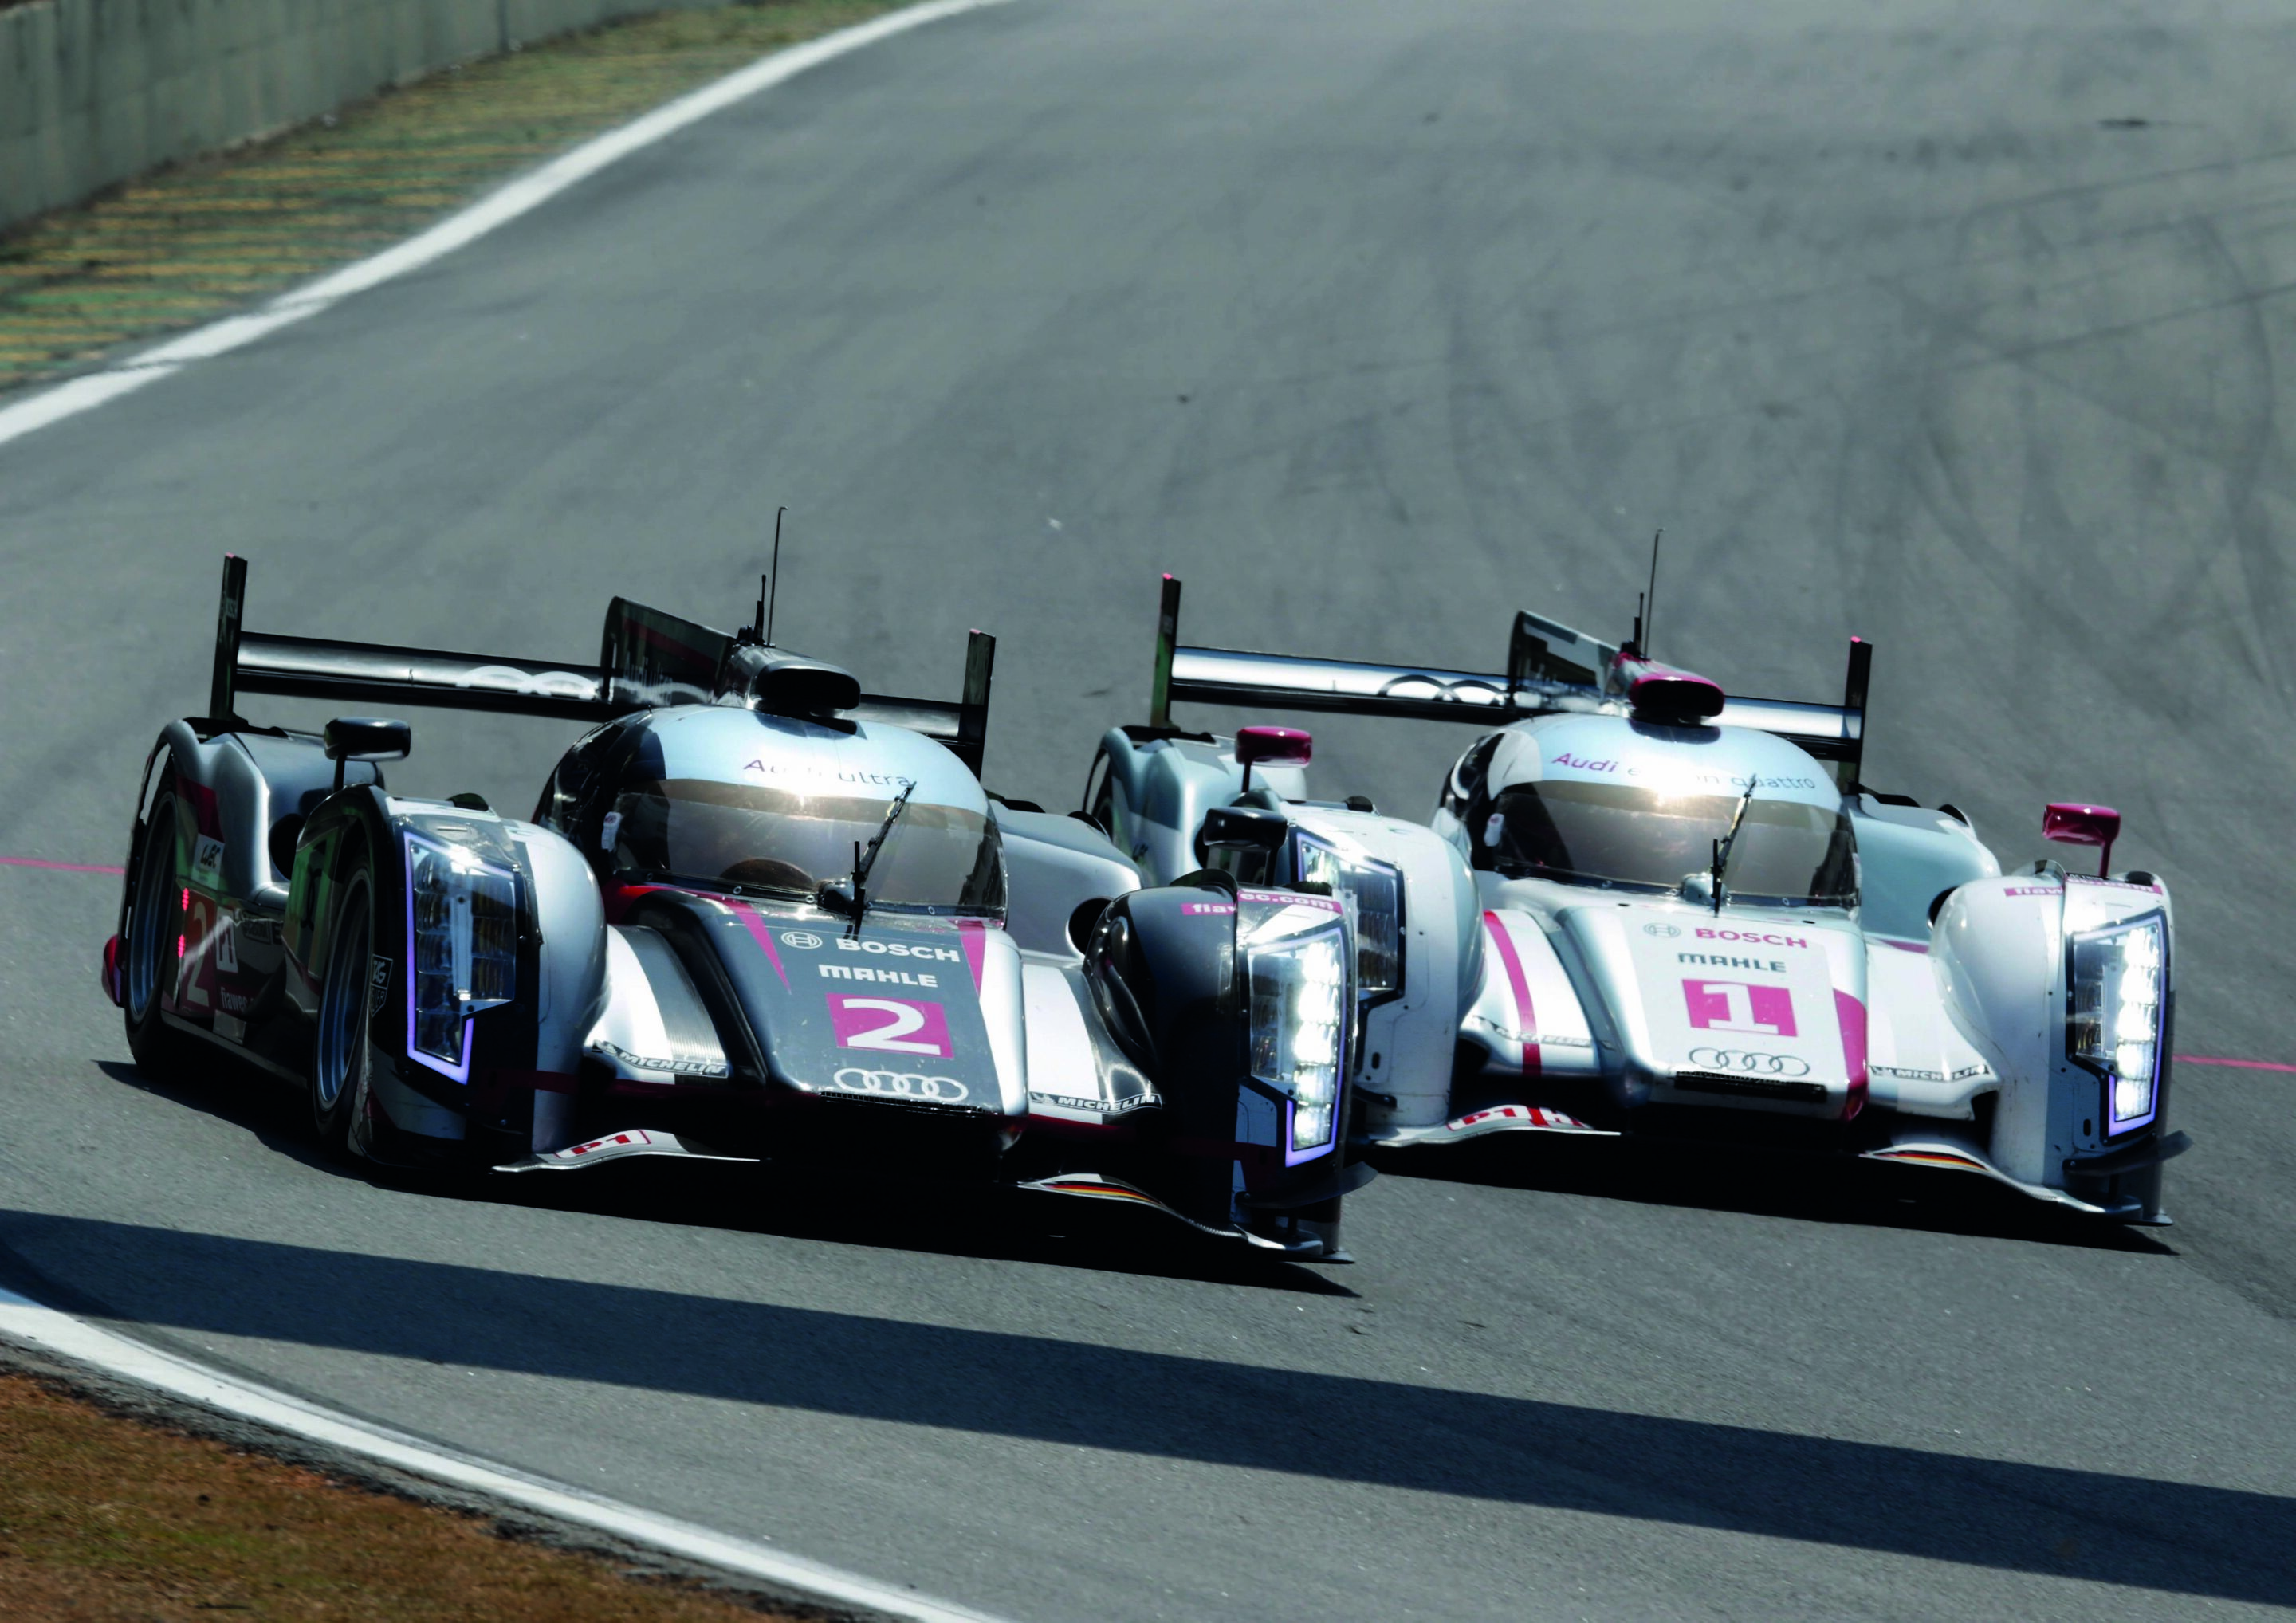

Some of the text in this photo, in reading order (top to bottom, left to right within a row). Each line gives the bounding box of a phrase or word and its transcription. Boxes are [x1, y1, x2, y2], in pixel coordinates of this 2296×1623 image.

[1551, 753, 1618, 772] Audi
[838, 771, 912, 788] ultra
[835, 937, 961, 962] BOSCH
[1695, 928, 1808, 949] BOSCH
[187, 901, 210, 1008] 2
[1677, 952, 1787, 973] MAHLE
[818, 964, 938, 988] MAHLE
[1702, 983, 1780, 1035] 1
[842, 998, 942, 1056] 2
[619, 1051, 724, 1074] MICHELIN
[1461, 1107, 1516, 1126] P1
[570, 1134, 632, 1156] P1
